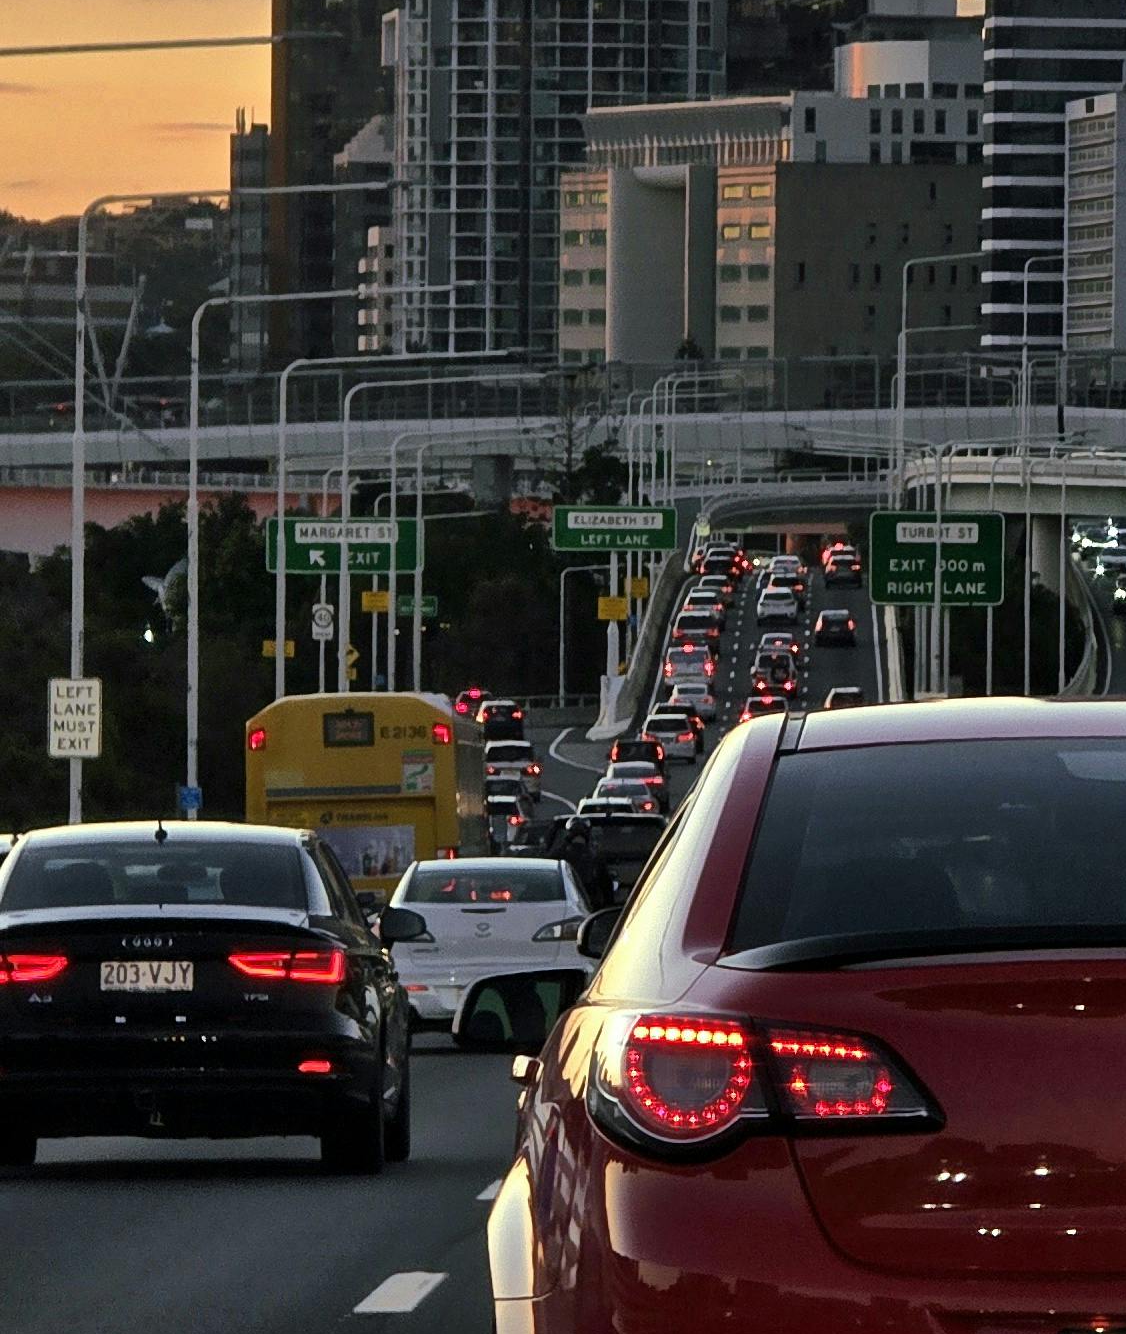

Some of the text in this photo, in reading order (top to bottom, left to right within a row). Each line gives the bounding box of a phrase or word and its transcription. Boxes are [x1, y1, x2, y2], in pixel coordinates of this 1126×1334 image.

[574, 516, 656, 525] ELIZABETH ST
[300, 527, 370, 538] MARGARET
[957, 528, 974, 539] ST
[581, 534, 649, 545] LEFT LANE
[889, 558, 926, 572] EXIT
[972, 562, 986, 572] m
[887, 581, 987, 595] RIGHT LANE
[56, 686, 93, 698] LEFT
[54, 703, 97, 716] LANE
[54, 719, 96, 733] MUST
[57, 736, 91, 750] EXIT
